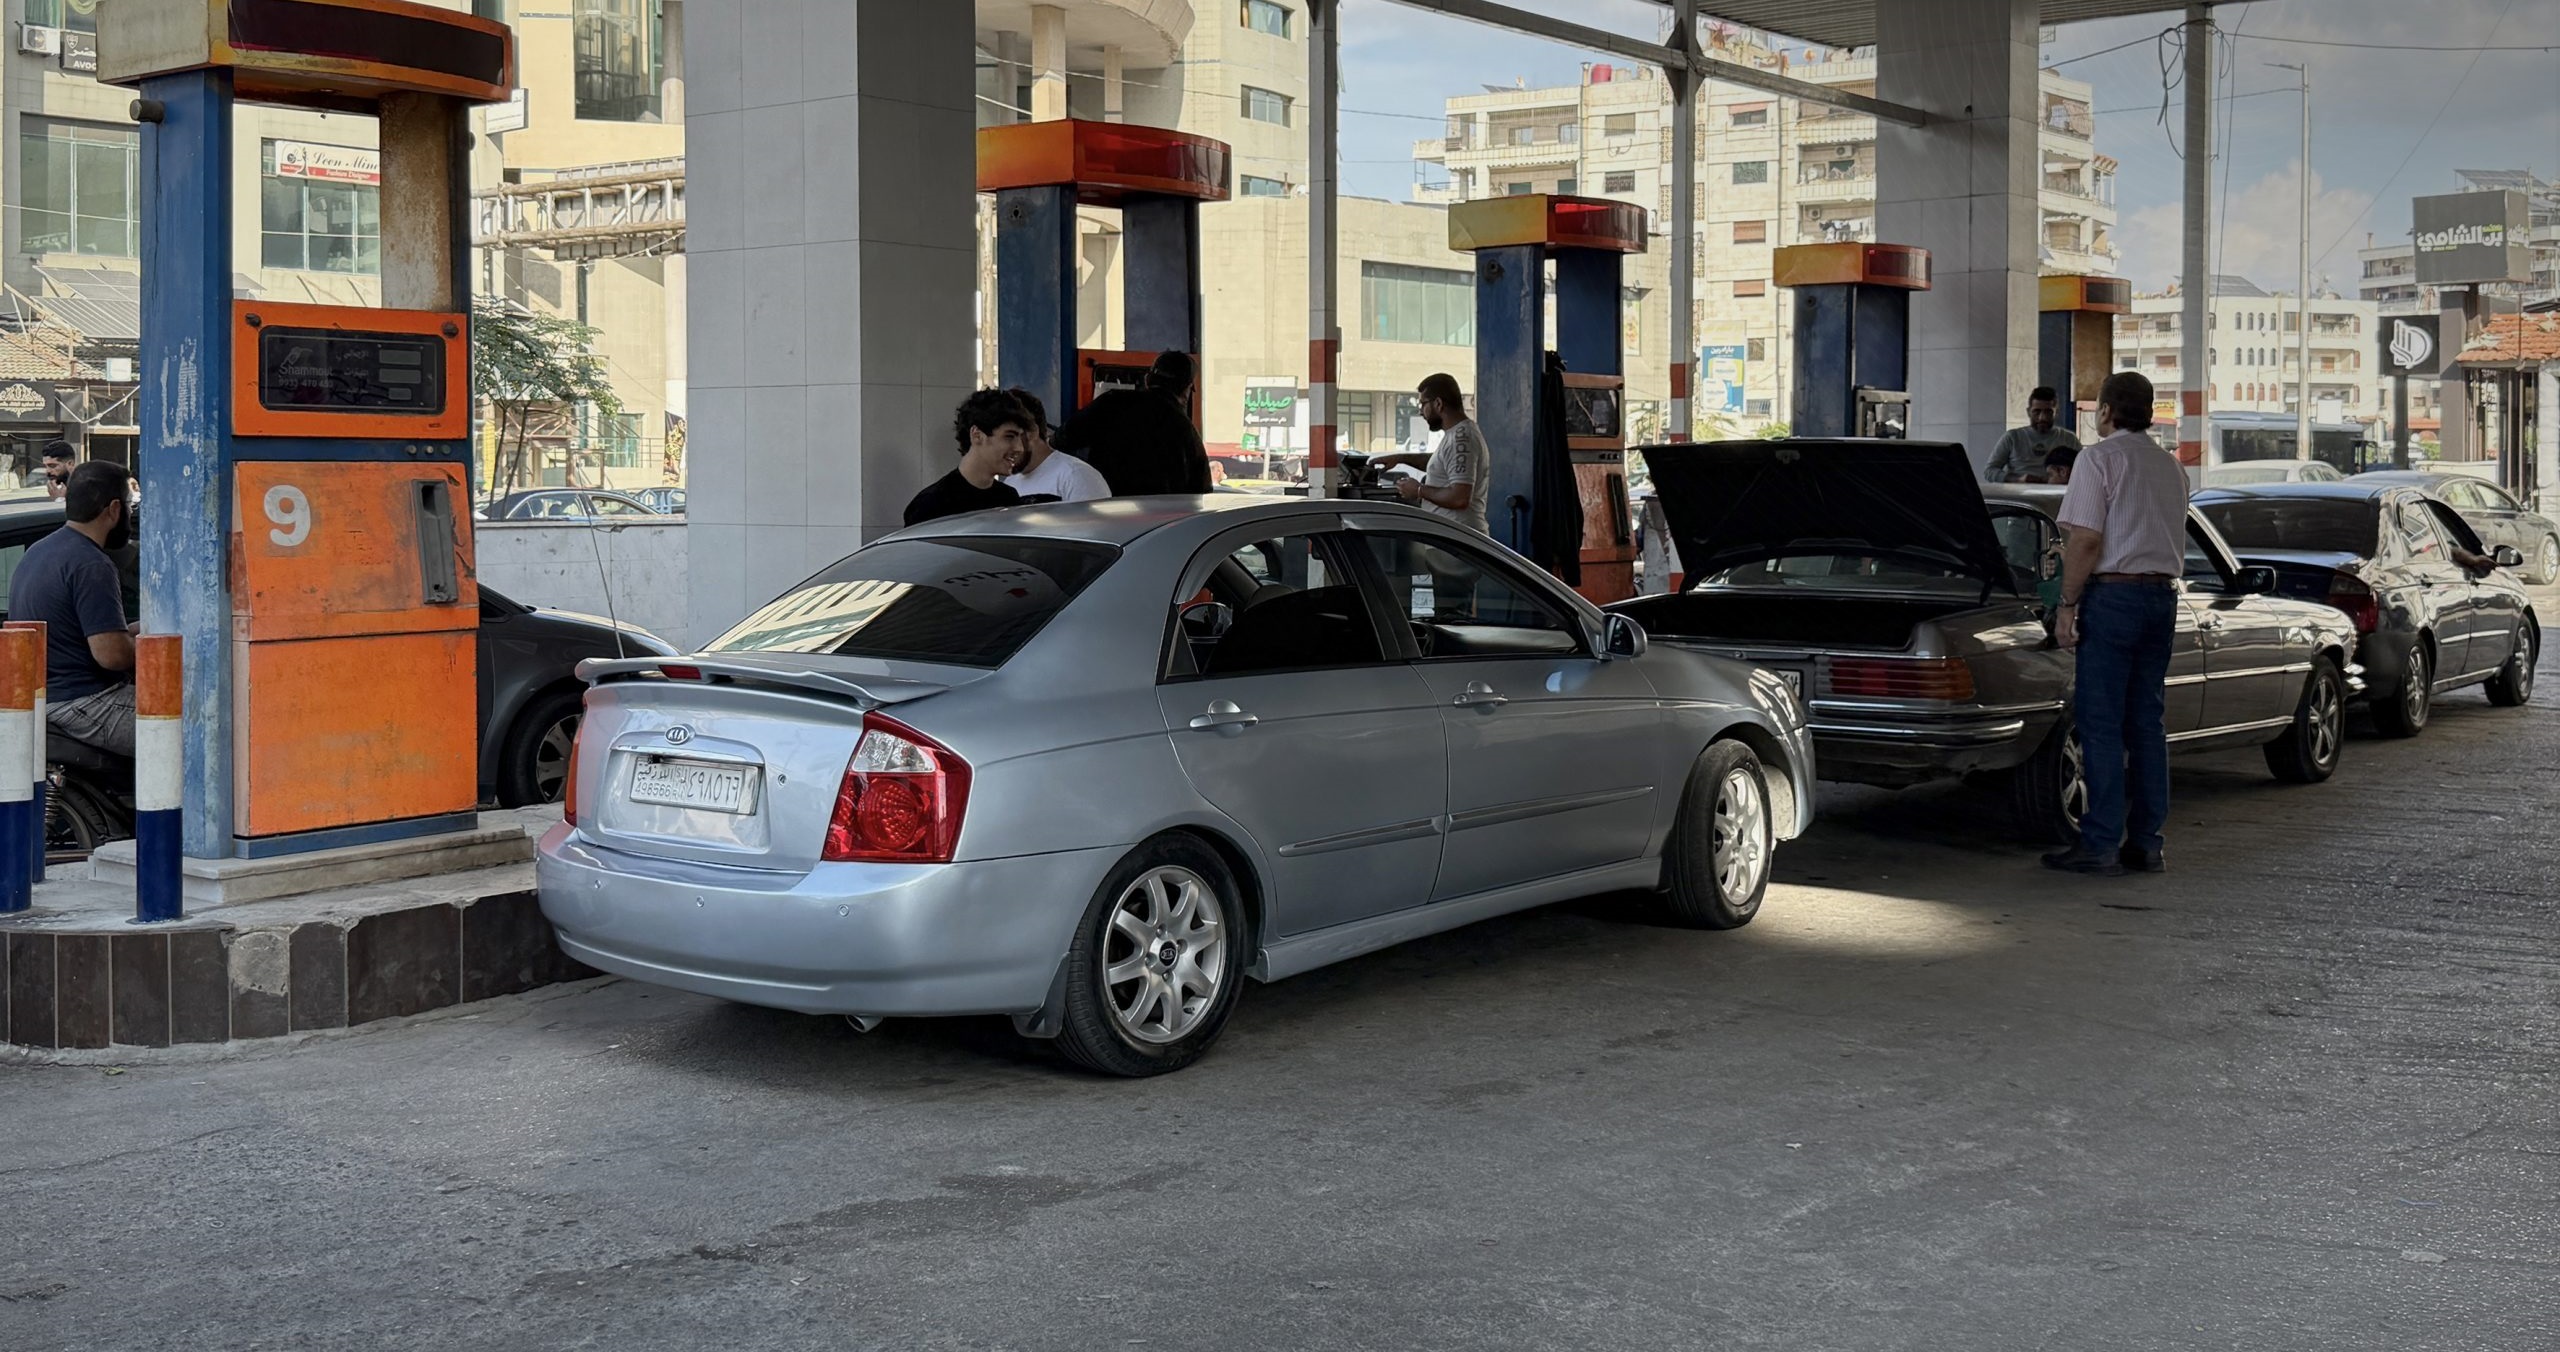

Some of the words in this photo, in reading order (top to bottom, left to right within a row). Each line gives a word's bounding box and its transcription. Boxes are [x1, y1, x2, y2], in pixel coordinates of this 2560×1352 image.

[1245, 387, 1292, 413] صيدلية
[1455, 425, 1470, 473] adidas
[264, 484, 311, 547] 9
[667, 729, 685, 741] KIA
[635, 781, 671, 797] 498566
